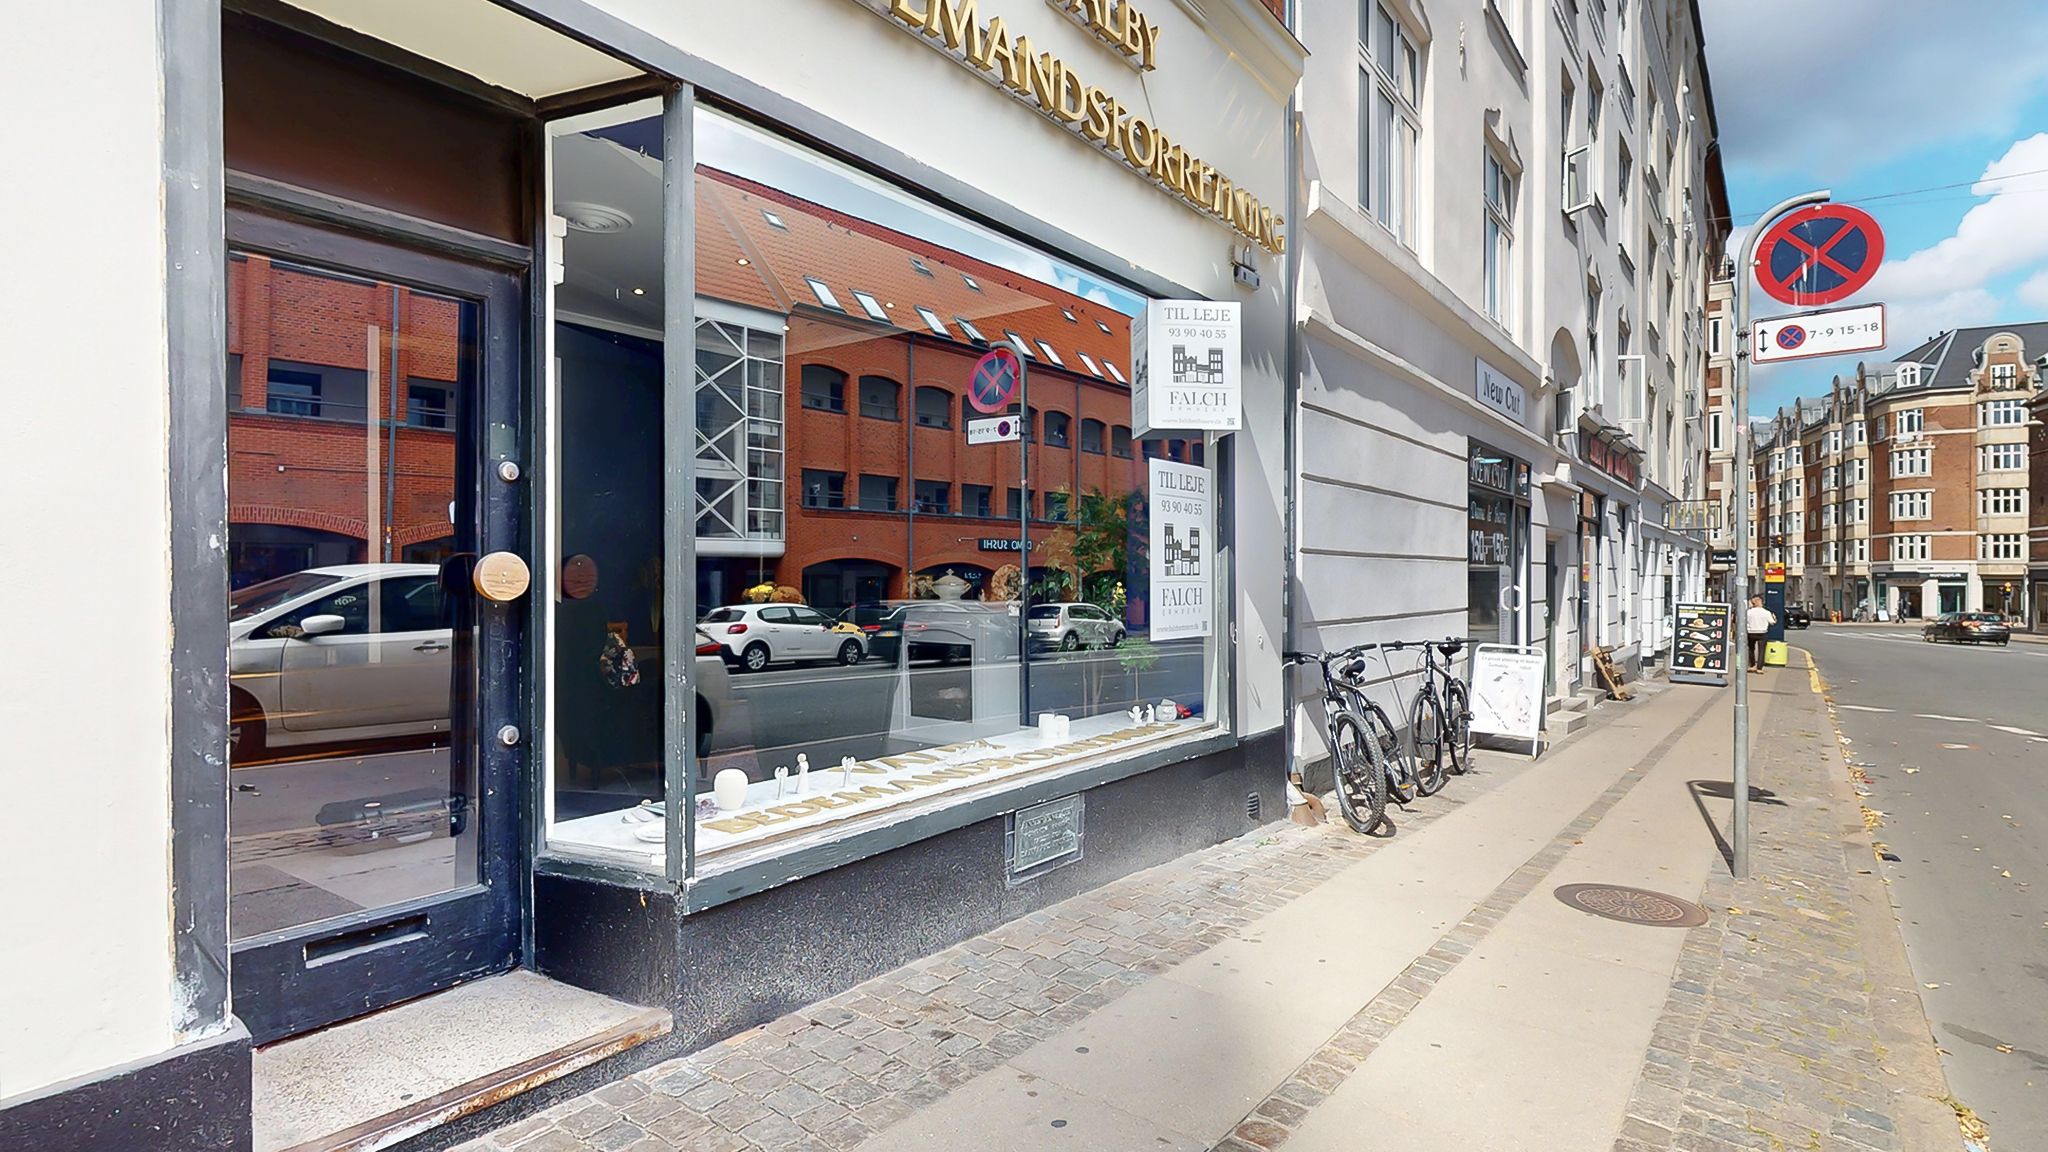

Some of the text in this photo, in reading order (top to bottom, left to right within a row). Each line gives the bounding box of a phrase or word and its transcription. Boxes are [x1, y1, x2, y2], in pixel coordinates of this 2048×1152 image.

[1164, 307, 1231, 322] TIL LEJE
[1168, 328, 1227, 340] 93 90 40 55
[1809, 322, 1880, 340] 7-9 15-18
[1169, 391, 1227, 407] FALCH
[1483, 371, 1521, 416] New Cut
[1158, 470, 1205, 494] TIL LEJE
[1161, 500, 1203, 516] 93 90 40 55
[1162, 588, 1203, 607] FALCH
